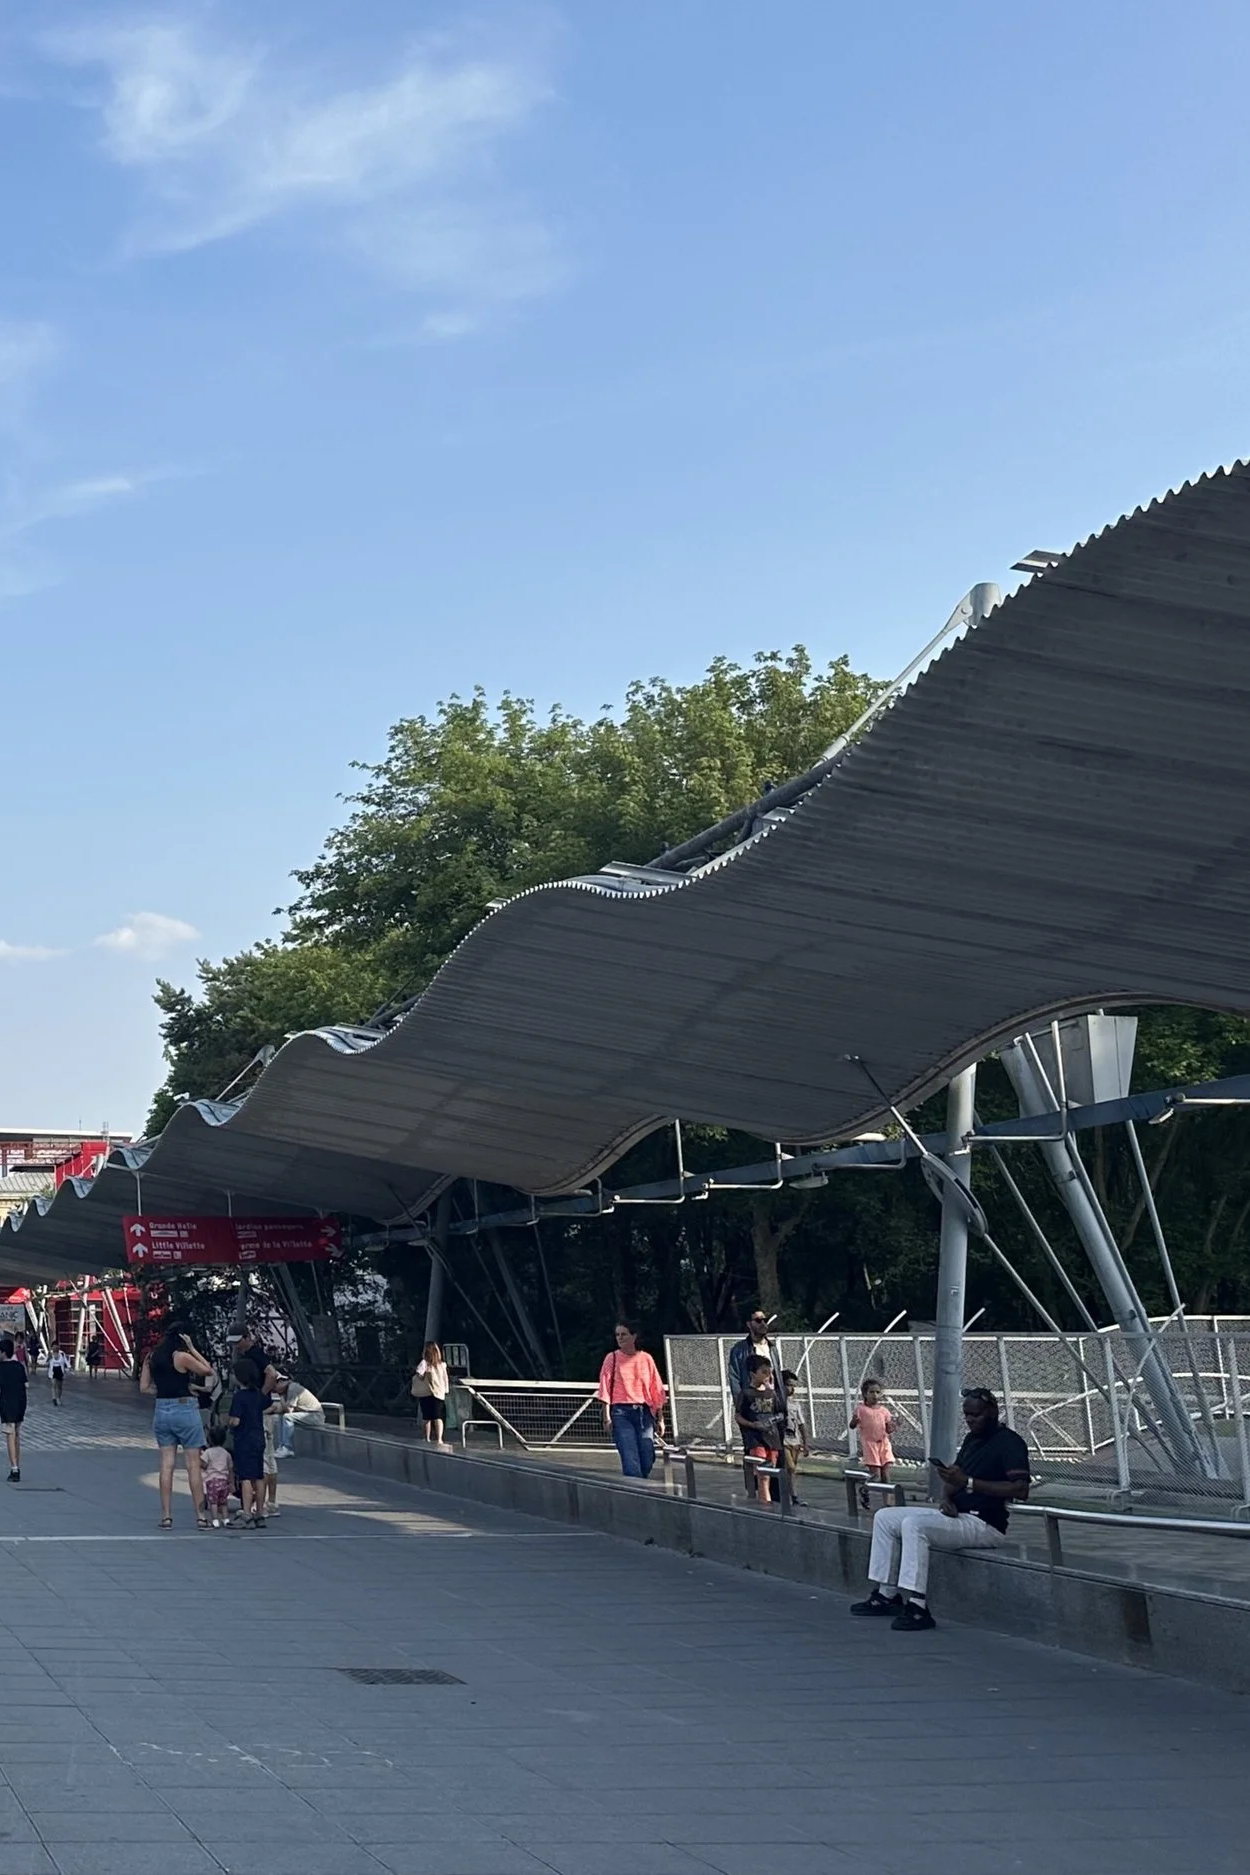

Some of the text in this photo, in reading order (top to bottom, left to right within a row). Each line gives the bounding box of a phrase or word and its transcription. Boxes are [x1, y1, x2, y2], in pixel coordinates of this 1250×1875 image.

[149, 1221, 176, 1230] Grande
[151, 1241, 206, 1250] Little Villette
